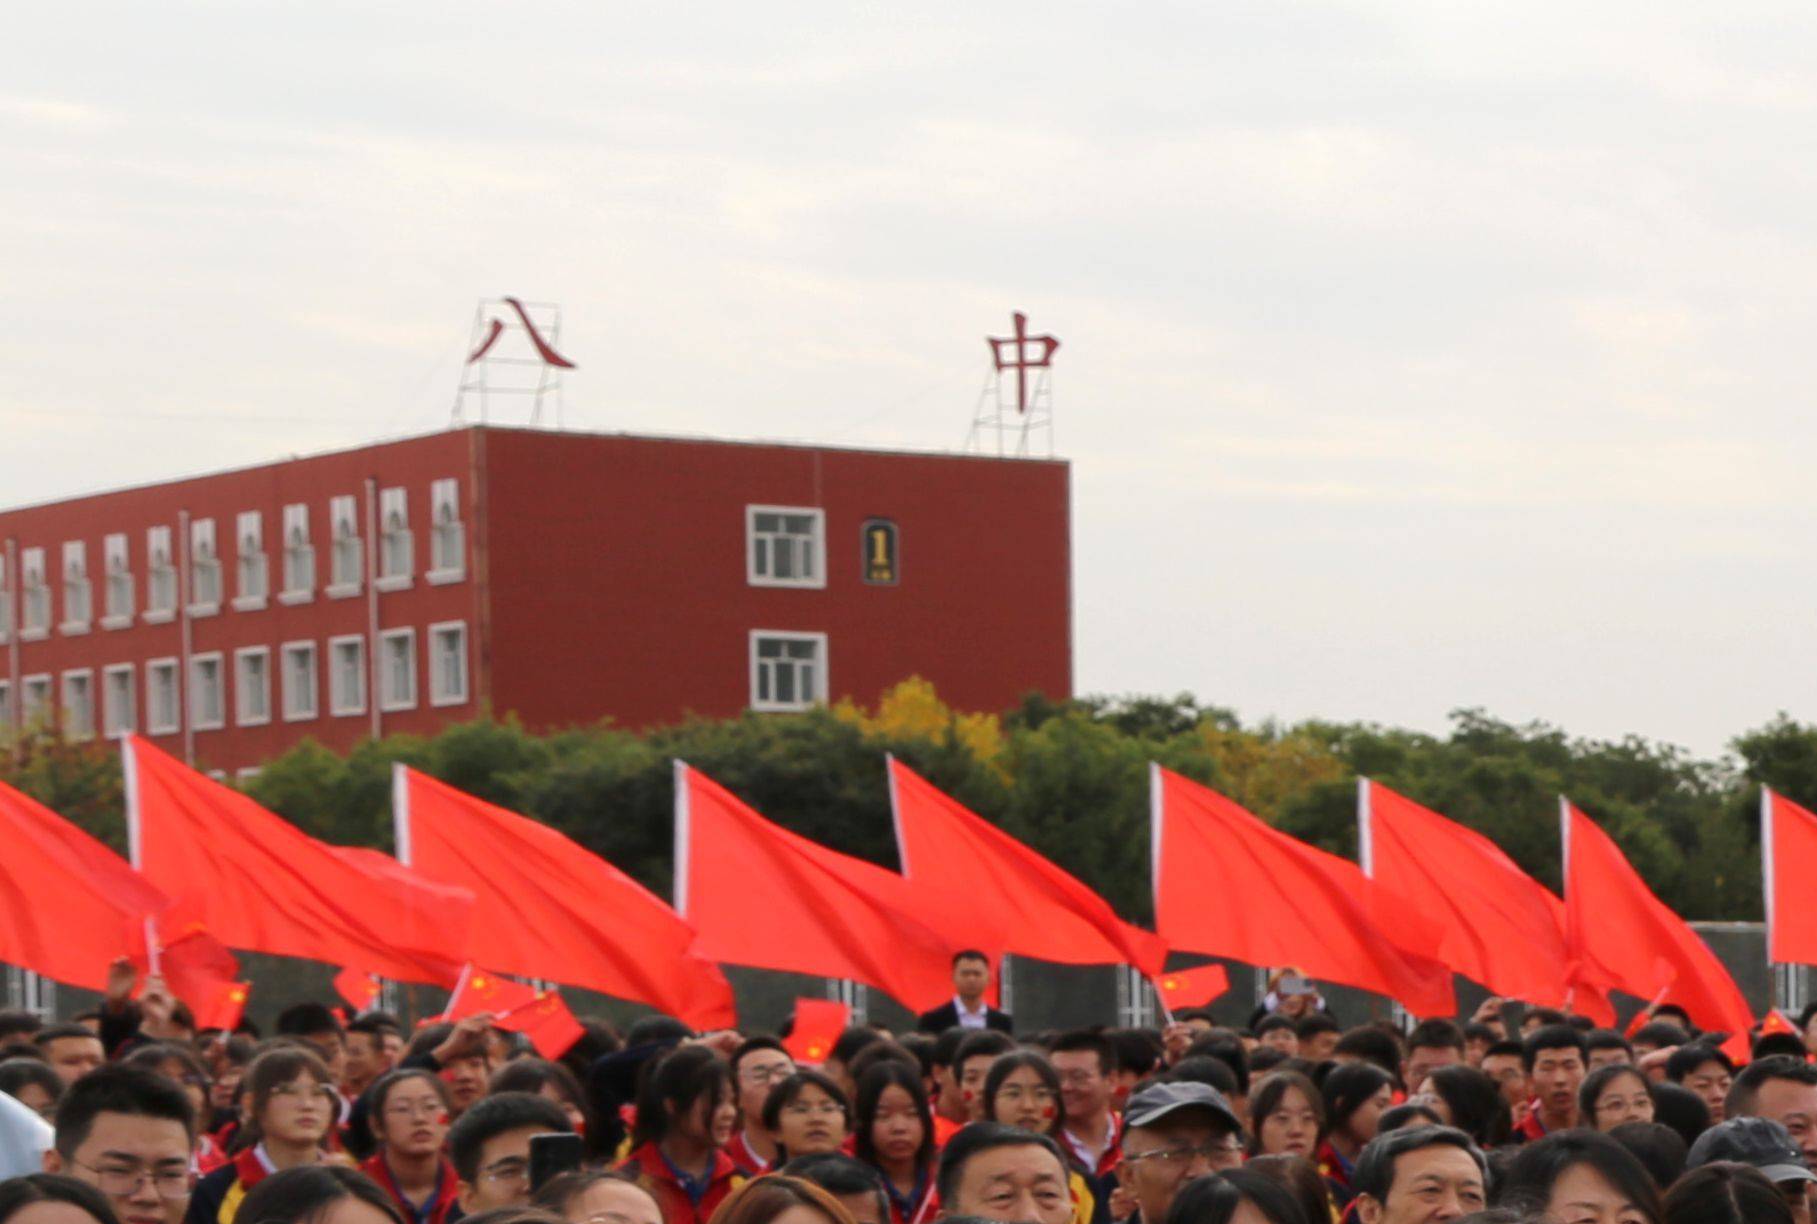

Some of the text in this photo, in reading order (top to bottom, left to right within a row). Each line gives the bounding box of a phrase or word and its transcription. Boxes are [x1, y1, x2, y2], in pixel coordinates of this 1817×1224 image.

[469, 297, 1060, 413] 八 中
[872, 529, 888, 566] 1
